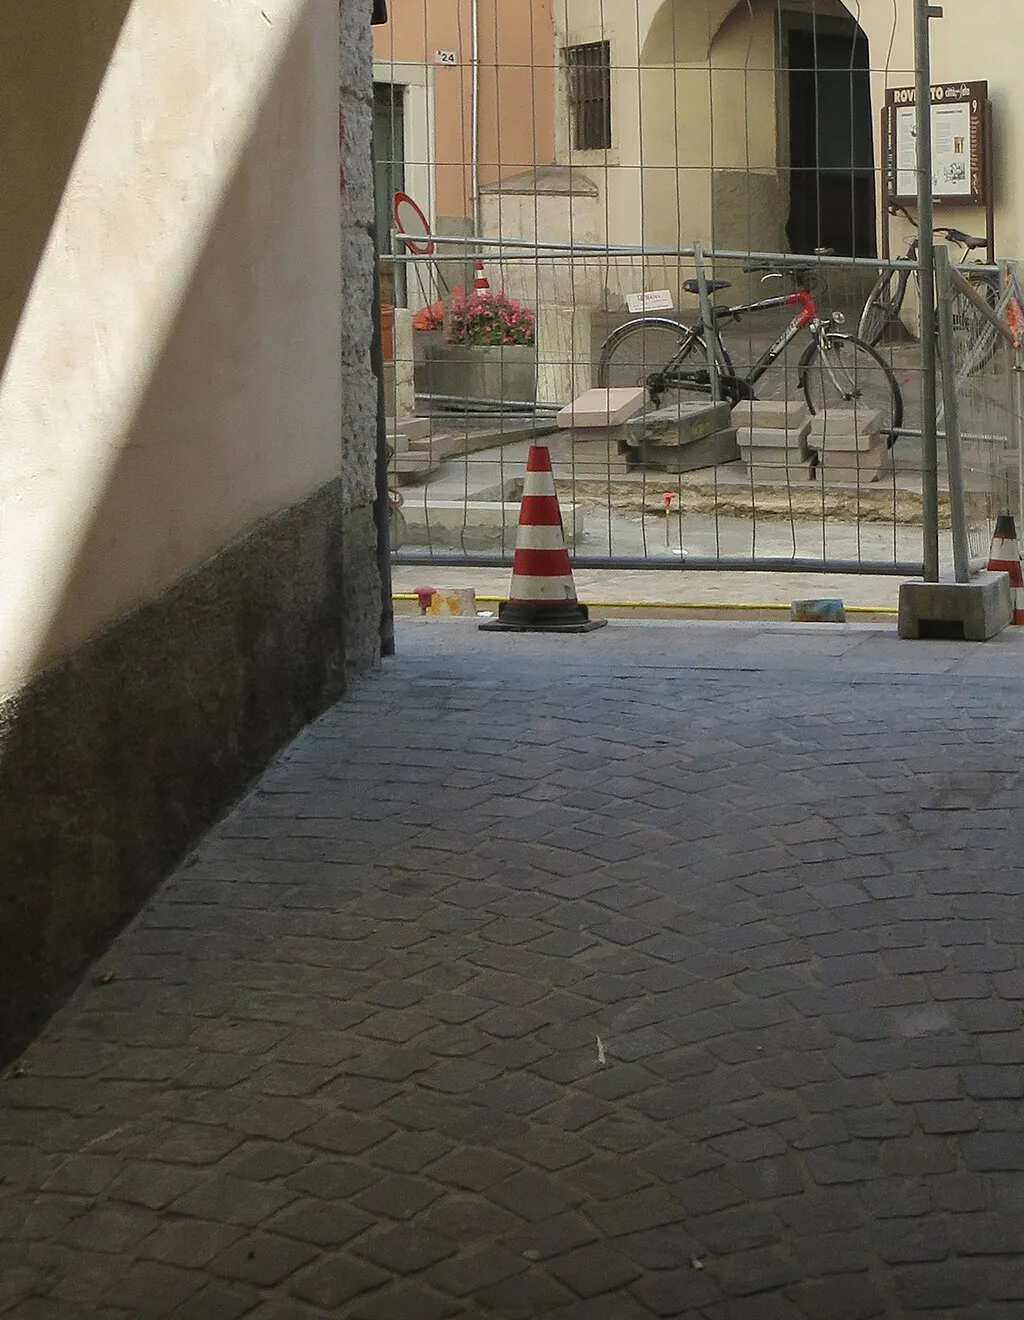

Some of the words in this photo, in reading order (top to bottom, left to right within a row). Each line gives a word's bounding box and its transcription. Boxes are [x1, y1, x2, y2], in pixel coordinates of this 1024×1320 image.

[441, 53, 455, 62] 24
[894, 86, 944, 104] ROVTO
[972, 99, 978, 113] 9
